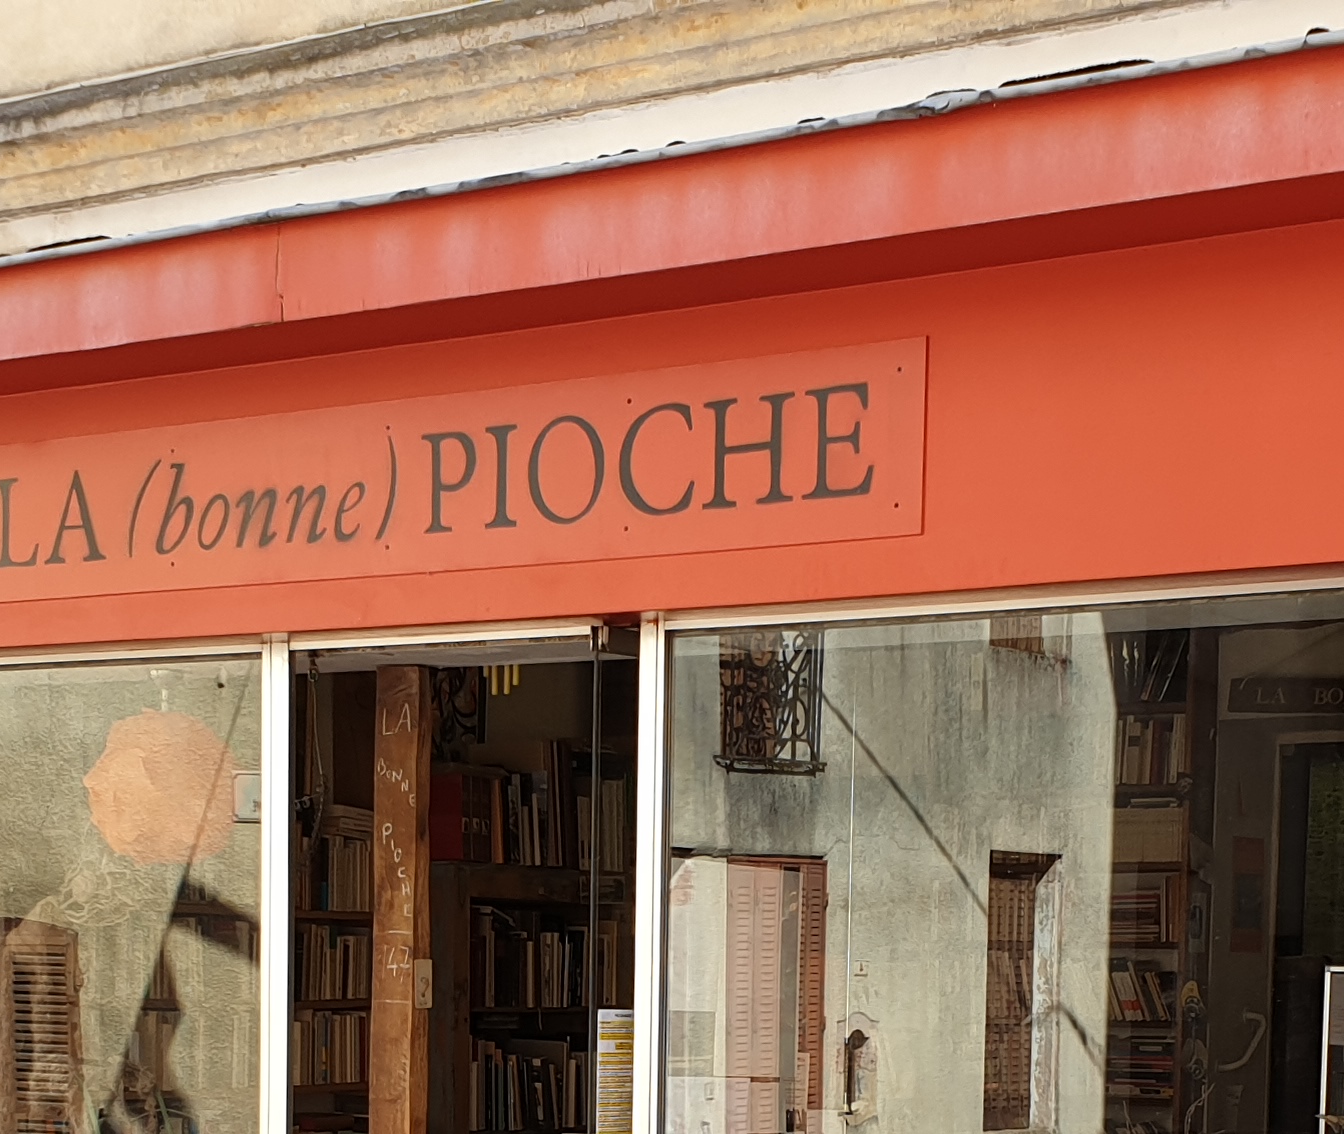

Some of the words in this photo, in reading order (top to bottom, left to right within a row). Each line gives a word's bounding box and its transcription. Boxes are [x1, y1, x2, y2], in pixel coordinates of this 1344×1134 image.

[128, 434, 398, 558] (bonne)
[421, 382, 875, 534] PIOCHE
[1256, 687, 1286, 704] LA
[382, 702, 411, 736] LA
